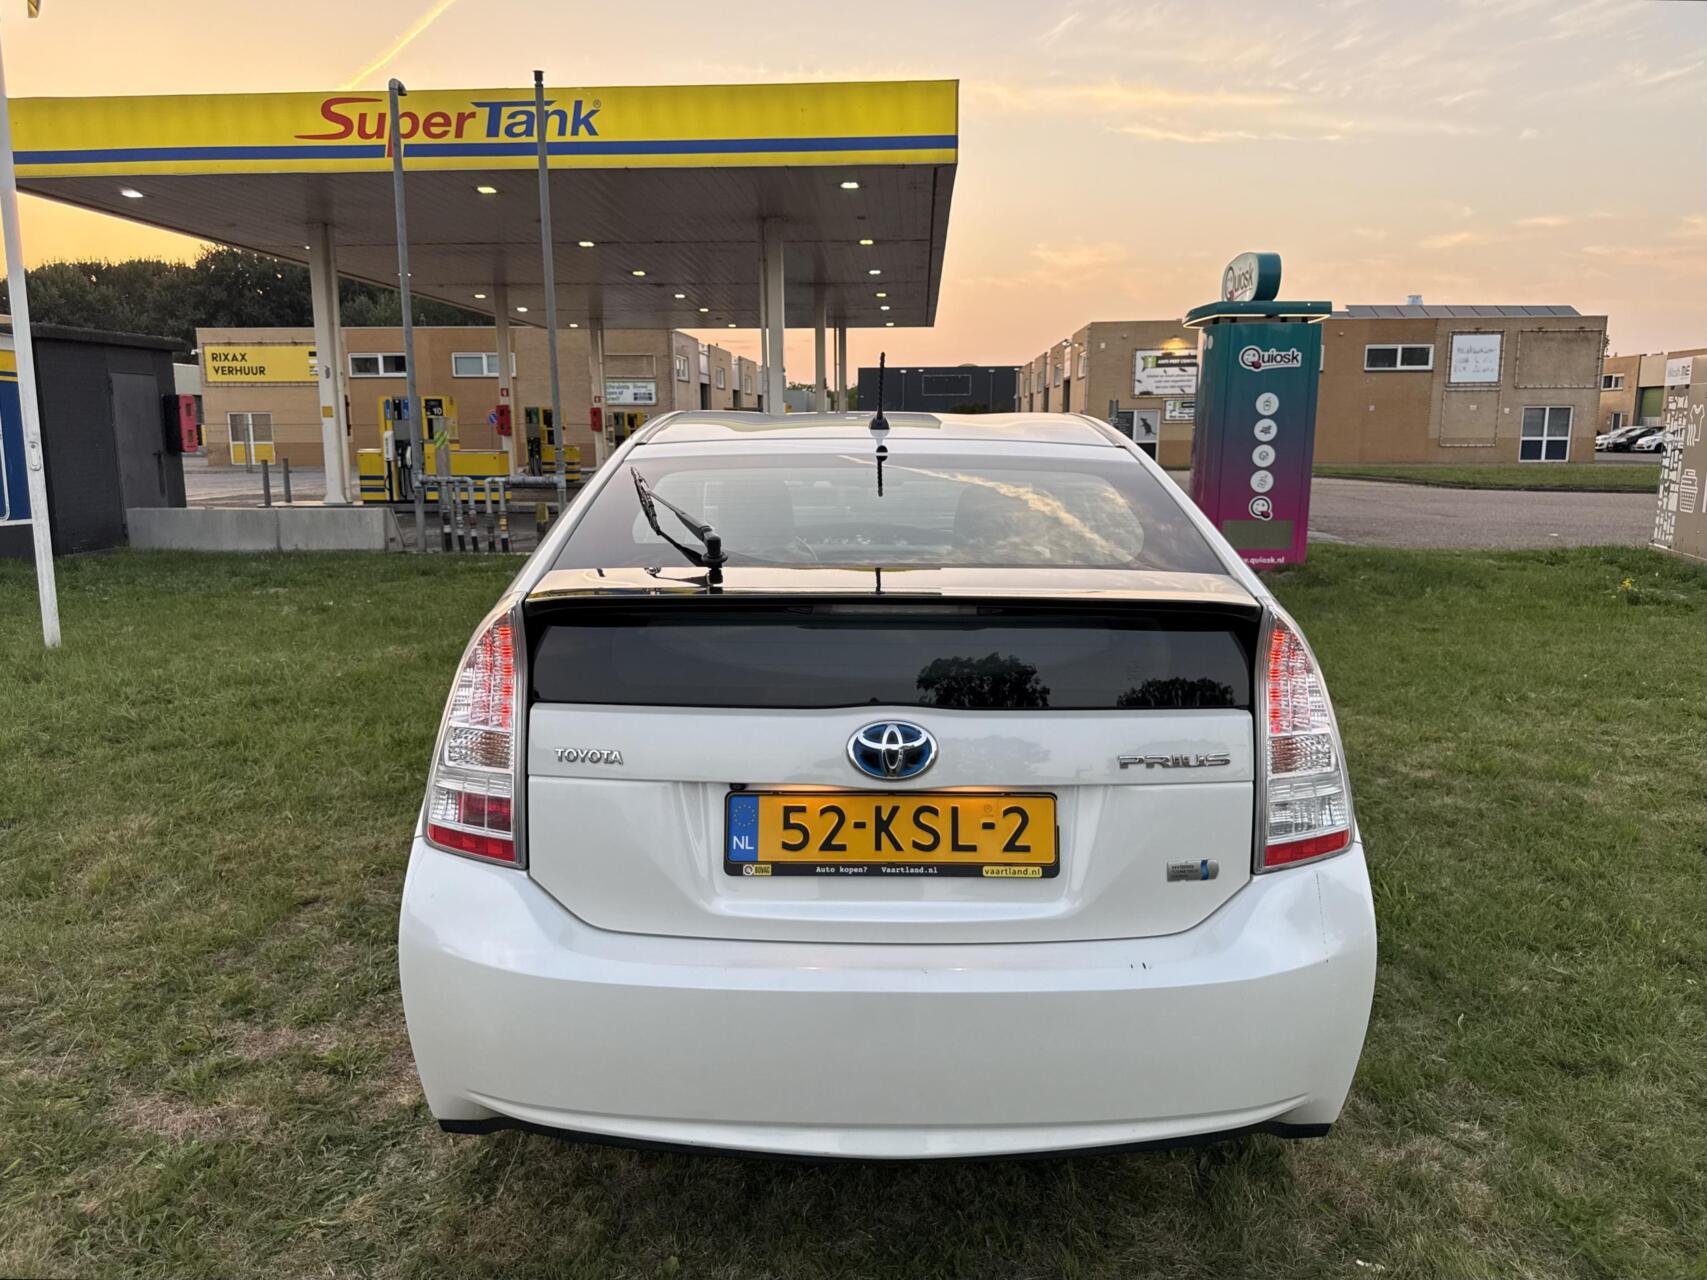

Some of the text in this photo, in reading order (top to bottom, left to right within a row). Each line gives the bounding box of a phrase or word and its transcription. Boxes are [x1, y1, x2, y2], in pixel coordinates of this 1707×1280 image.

[1225, 261, 1255, 301] Quiosk
[211, 352, 247, 362] RIXAX
[1241, 347, 1300, 369] Quiosk
[213, 366, 266, 376] VERHUUR
[1242, 556, 1285, 564] w.quiosk.nl
[554, 747, 623, 765] TOYOTA
[1118, 752, 1231, 769] PRIUS
[780, 804, 1031, 853] 52-KSL-2
[732, 835, 755, 850] NL
[839, 866, 868, 875] kopen?
[881, 866, 938, 874] Vaartland.nl
[984, 866, 1041, 877] vaartland.nl
